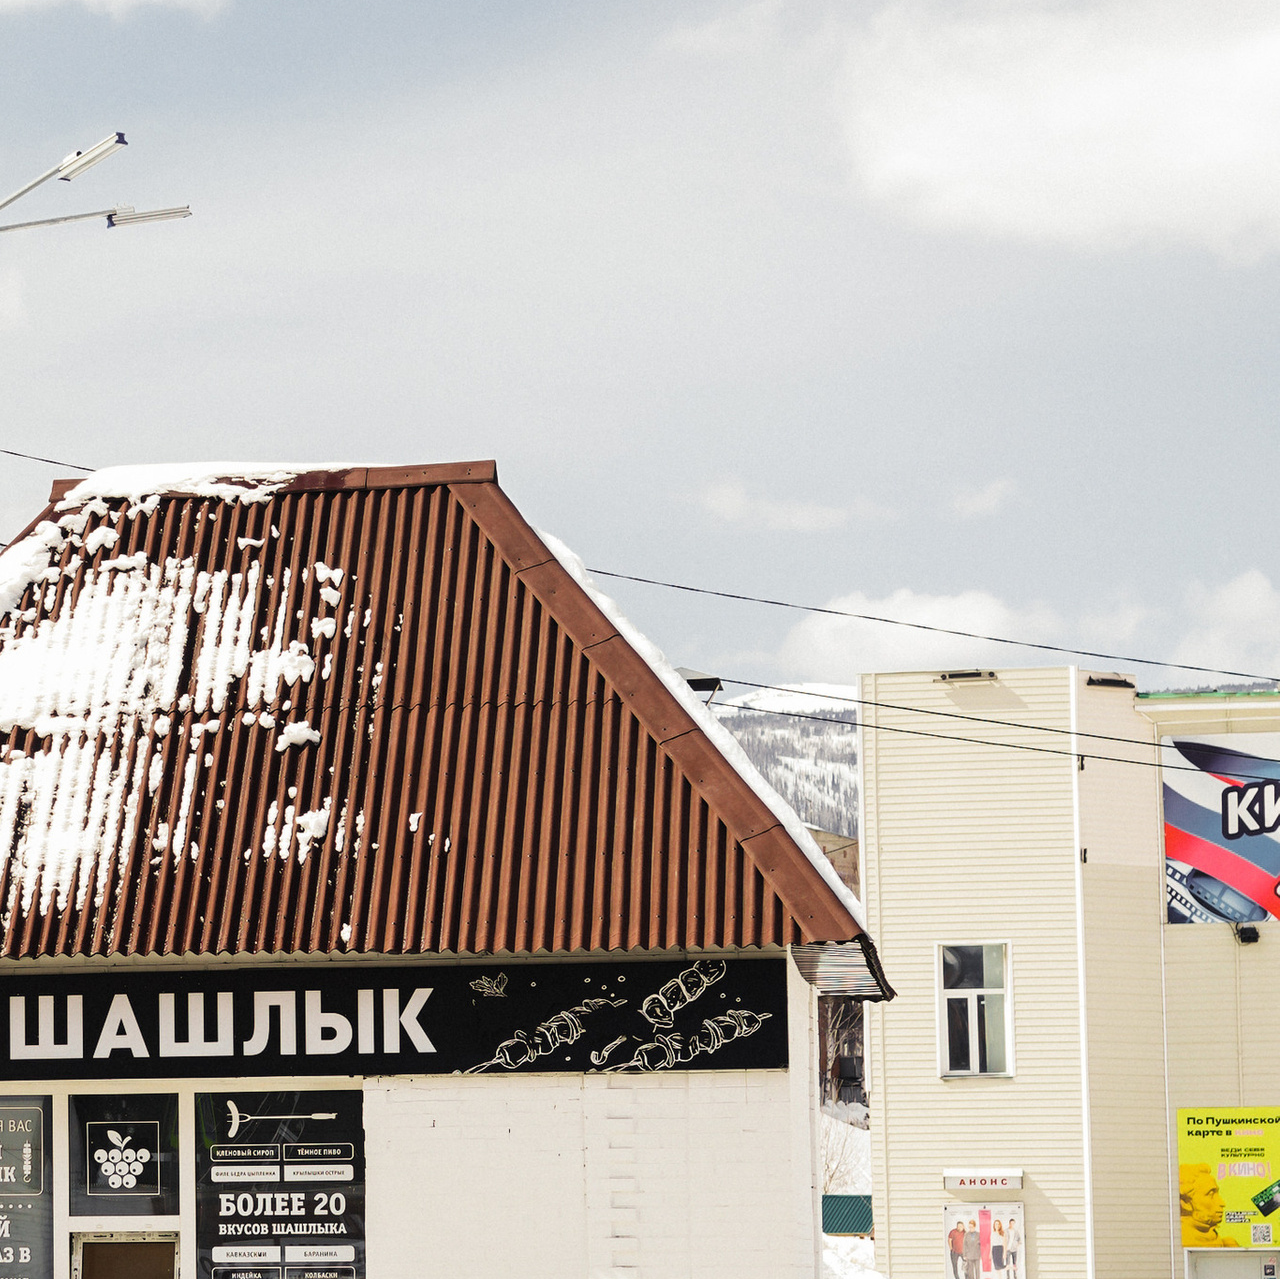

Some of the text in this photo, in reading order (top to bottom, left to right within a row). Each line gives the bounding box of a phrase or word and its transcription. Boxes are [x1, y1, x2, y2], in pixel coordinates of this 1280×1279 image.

[9, 988, 437, 1060] ШАШЛЫК
[8, 1119, 33, 1133] ВАС
[1187, 1116, 1280, 1126] По Пушкинской
[1187, 1129, 1223, 1138] карте
[216, 1148, 275, 1157] КЛЕНОВЫЙ СИРОП
[297, 1148, 322, 1156] ТЁМНОЕ
[1217, 1163, 1227, 1180] В
[959, 1178, 1008, 1186] АНОНС
[219, 1192, 346, 1217] БОЛЕЕ 20
[218, 1223, 347, 1235] ВКУСОВ ШАШЛЫКА
[19, 1247, 31, 1263] В
[231, 1271, 262, 1279] ИНДЕЙКА
[304, 1271, 338, 1279] КОЛБАСКИ
